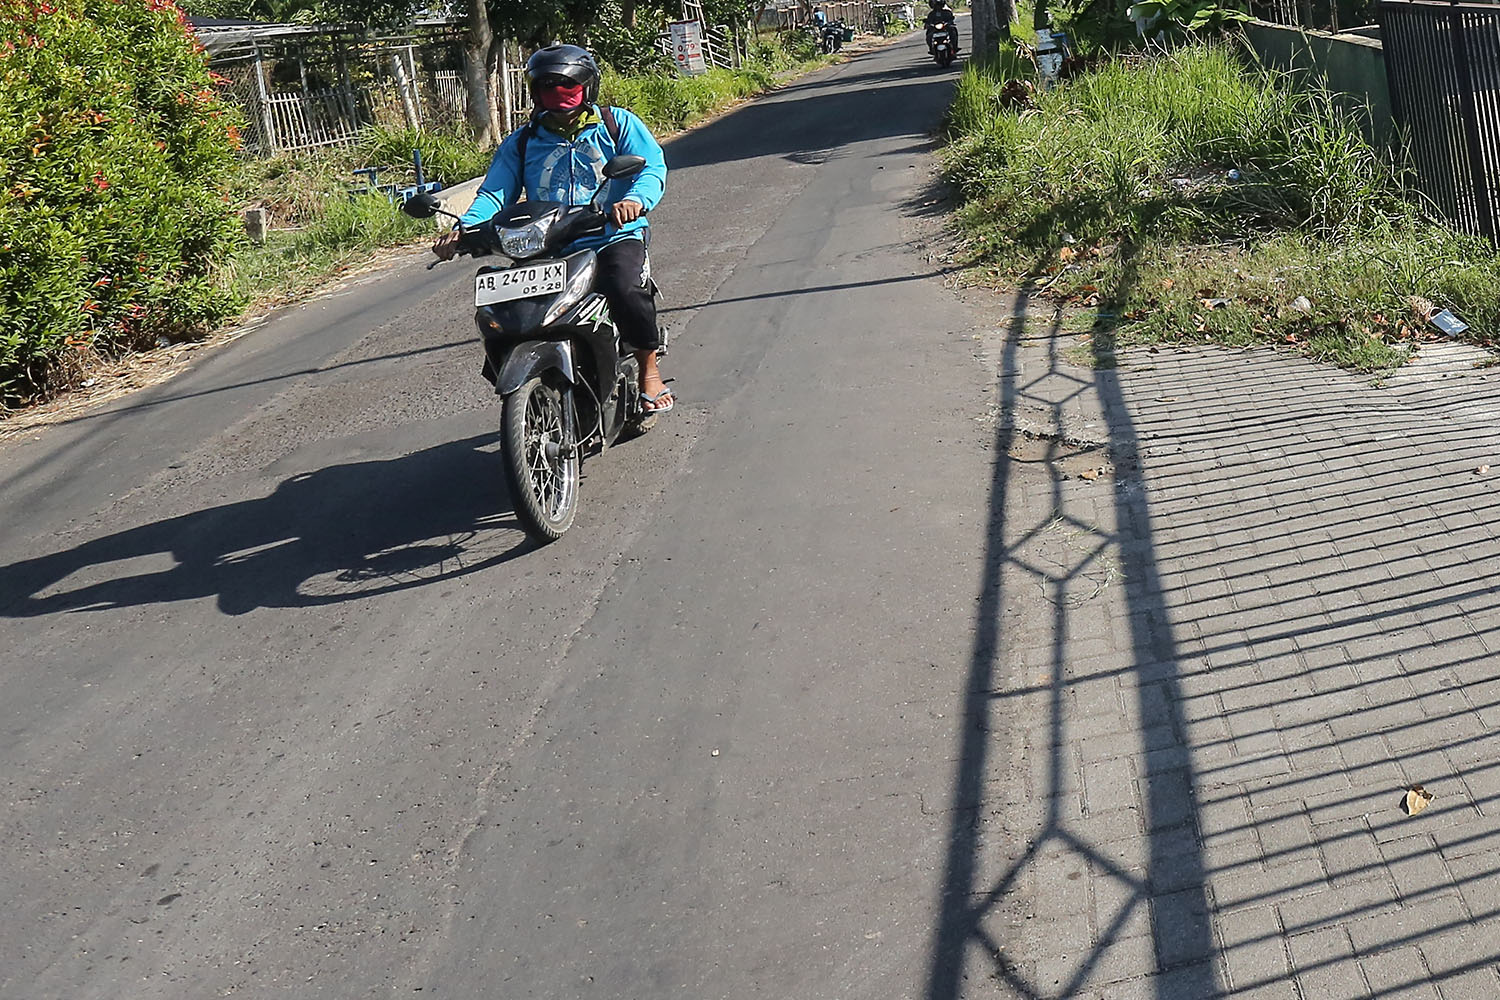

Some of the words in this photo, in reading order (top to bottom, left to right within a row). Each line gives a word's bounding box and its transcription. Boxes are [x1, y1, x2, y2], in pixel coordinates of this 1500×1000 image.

[478, 277, 495, 290] AB
[502, 269, 536, 286] 2470
[543, 265, 562, 281] KX
